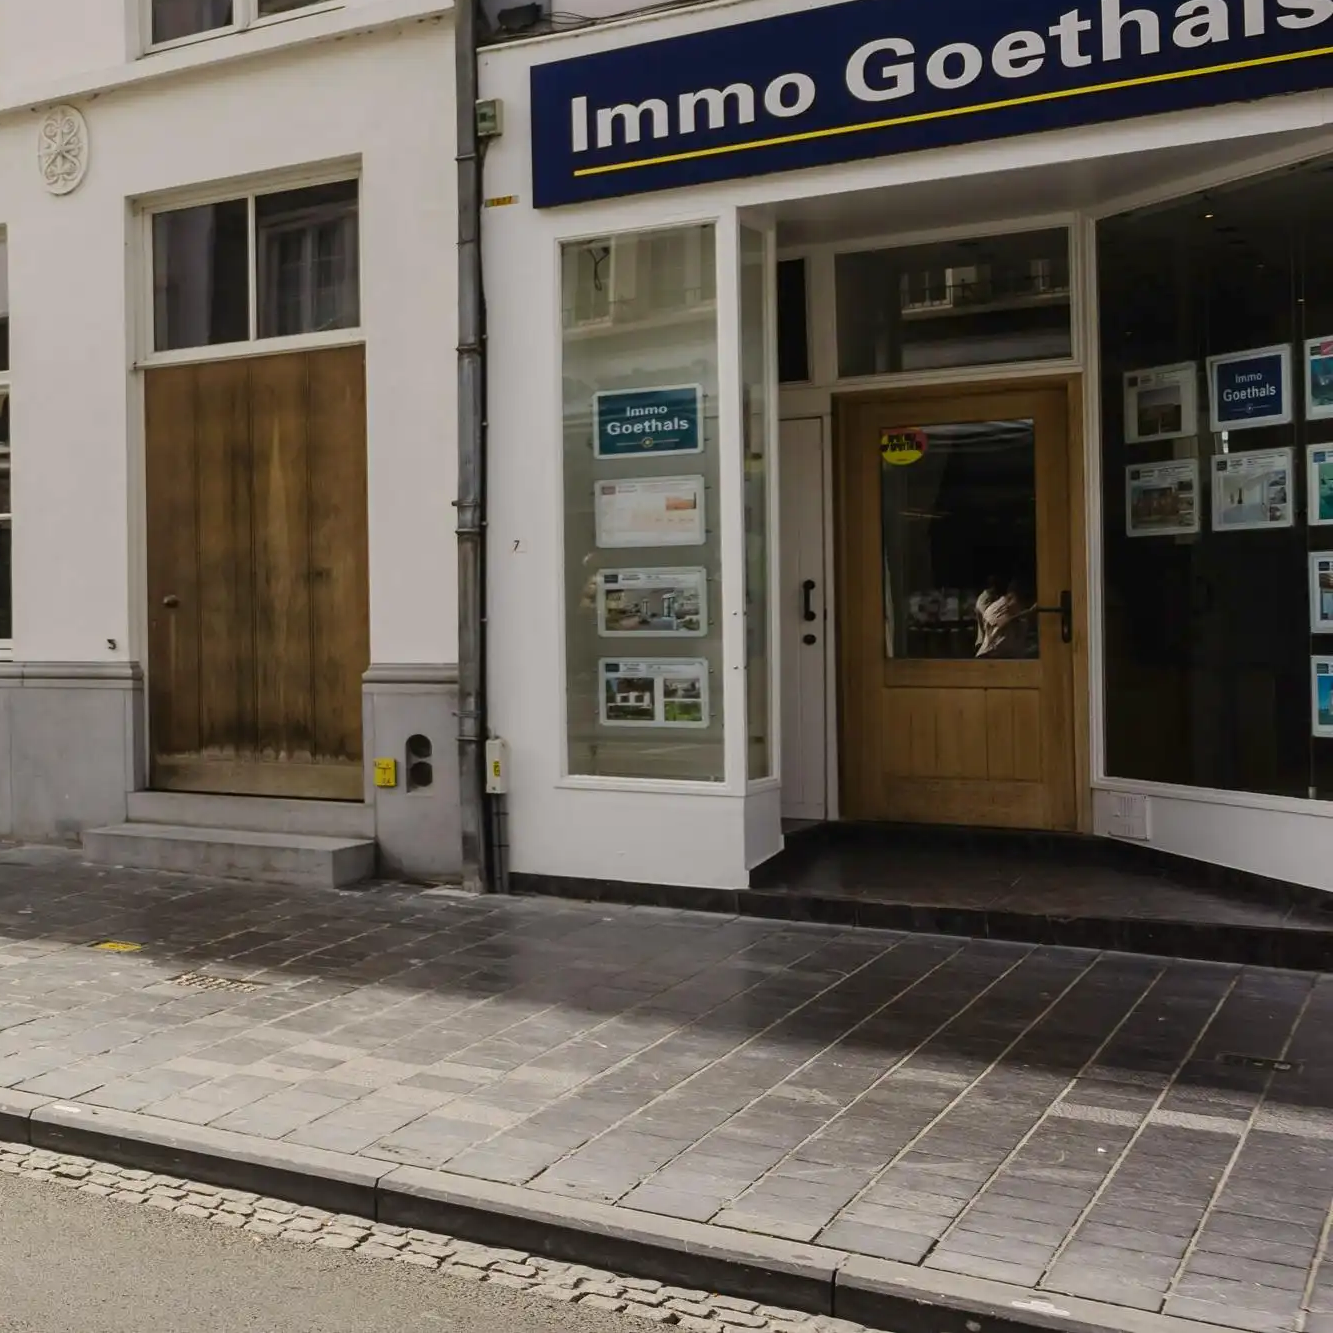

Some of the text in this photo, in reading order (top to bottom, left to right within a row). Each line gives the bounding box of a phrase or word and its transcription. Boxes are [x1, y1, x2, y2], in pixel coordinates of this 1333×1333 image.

[570, 70, 816, 153] Immo
[1234, 372, 1263, 384] Immo
[1222, 383, 1277, 402] Goethals
[626, 406, 669, 417] Immo
[606, 416, 690, 436] Goethals
[513, 539, 520, 552] 7
